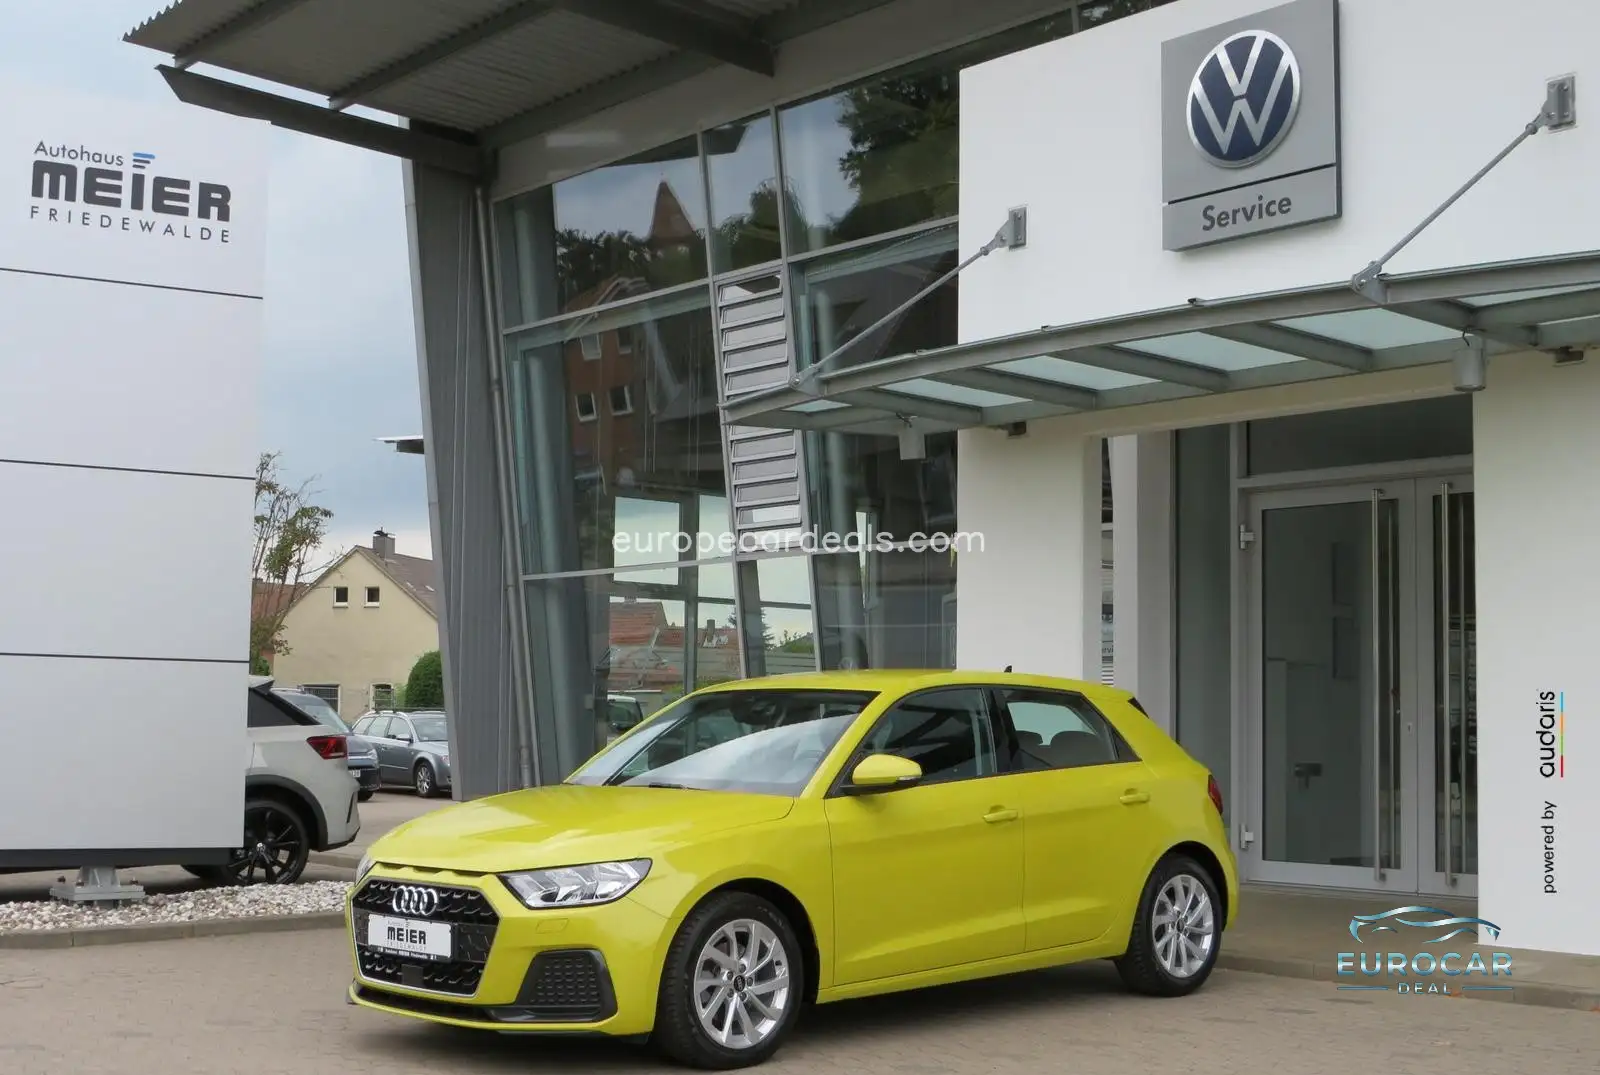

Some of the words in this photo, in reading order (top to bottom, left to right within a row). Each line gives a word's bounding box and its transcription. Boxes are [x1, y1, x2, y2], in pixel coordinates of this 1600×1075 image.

[34, 140, 124, 167] Autohaus
[31, 158, 232, 223] MEIER
[30, 205, 231, 243] FRIEDEWALDE
[1202, 194, 1292, 232] Service
[387, 926, 426, 945] MEIER
